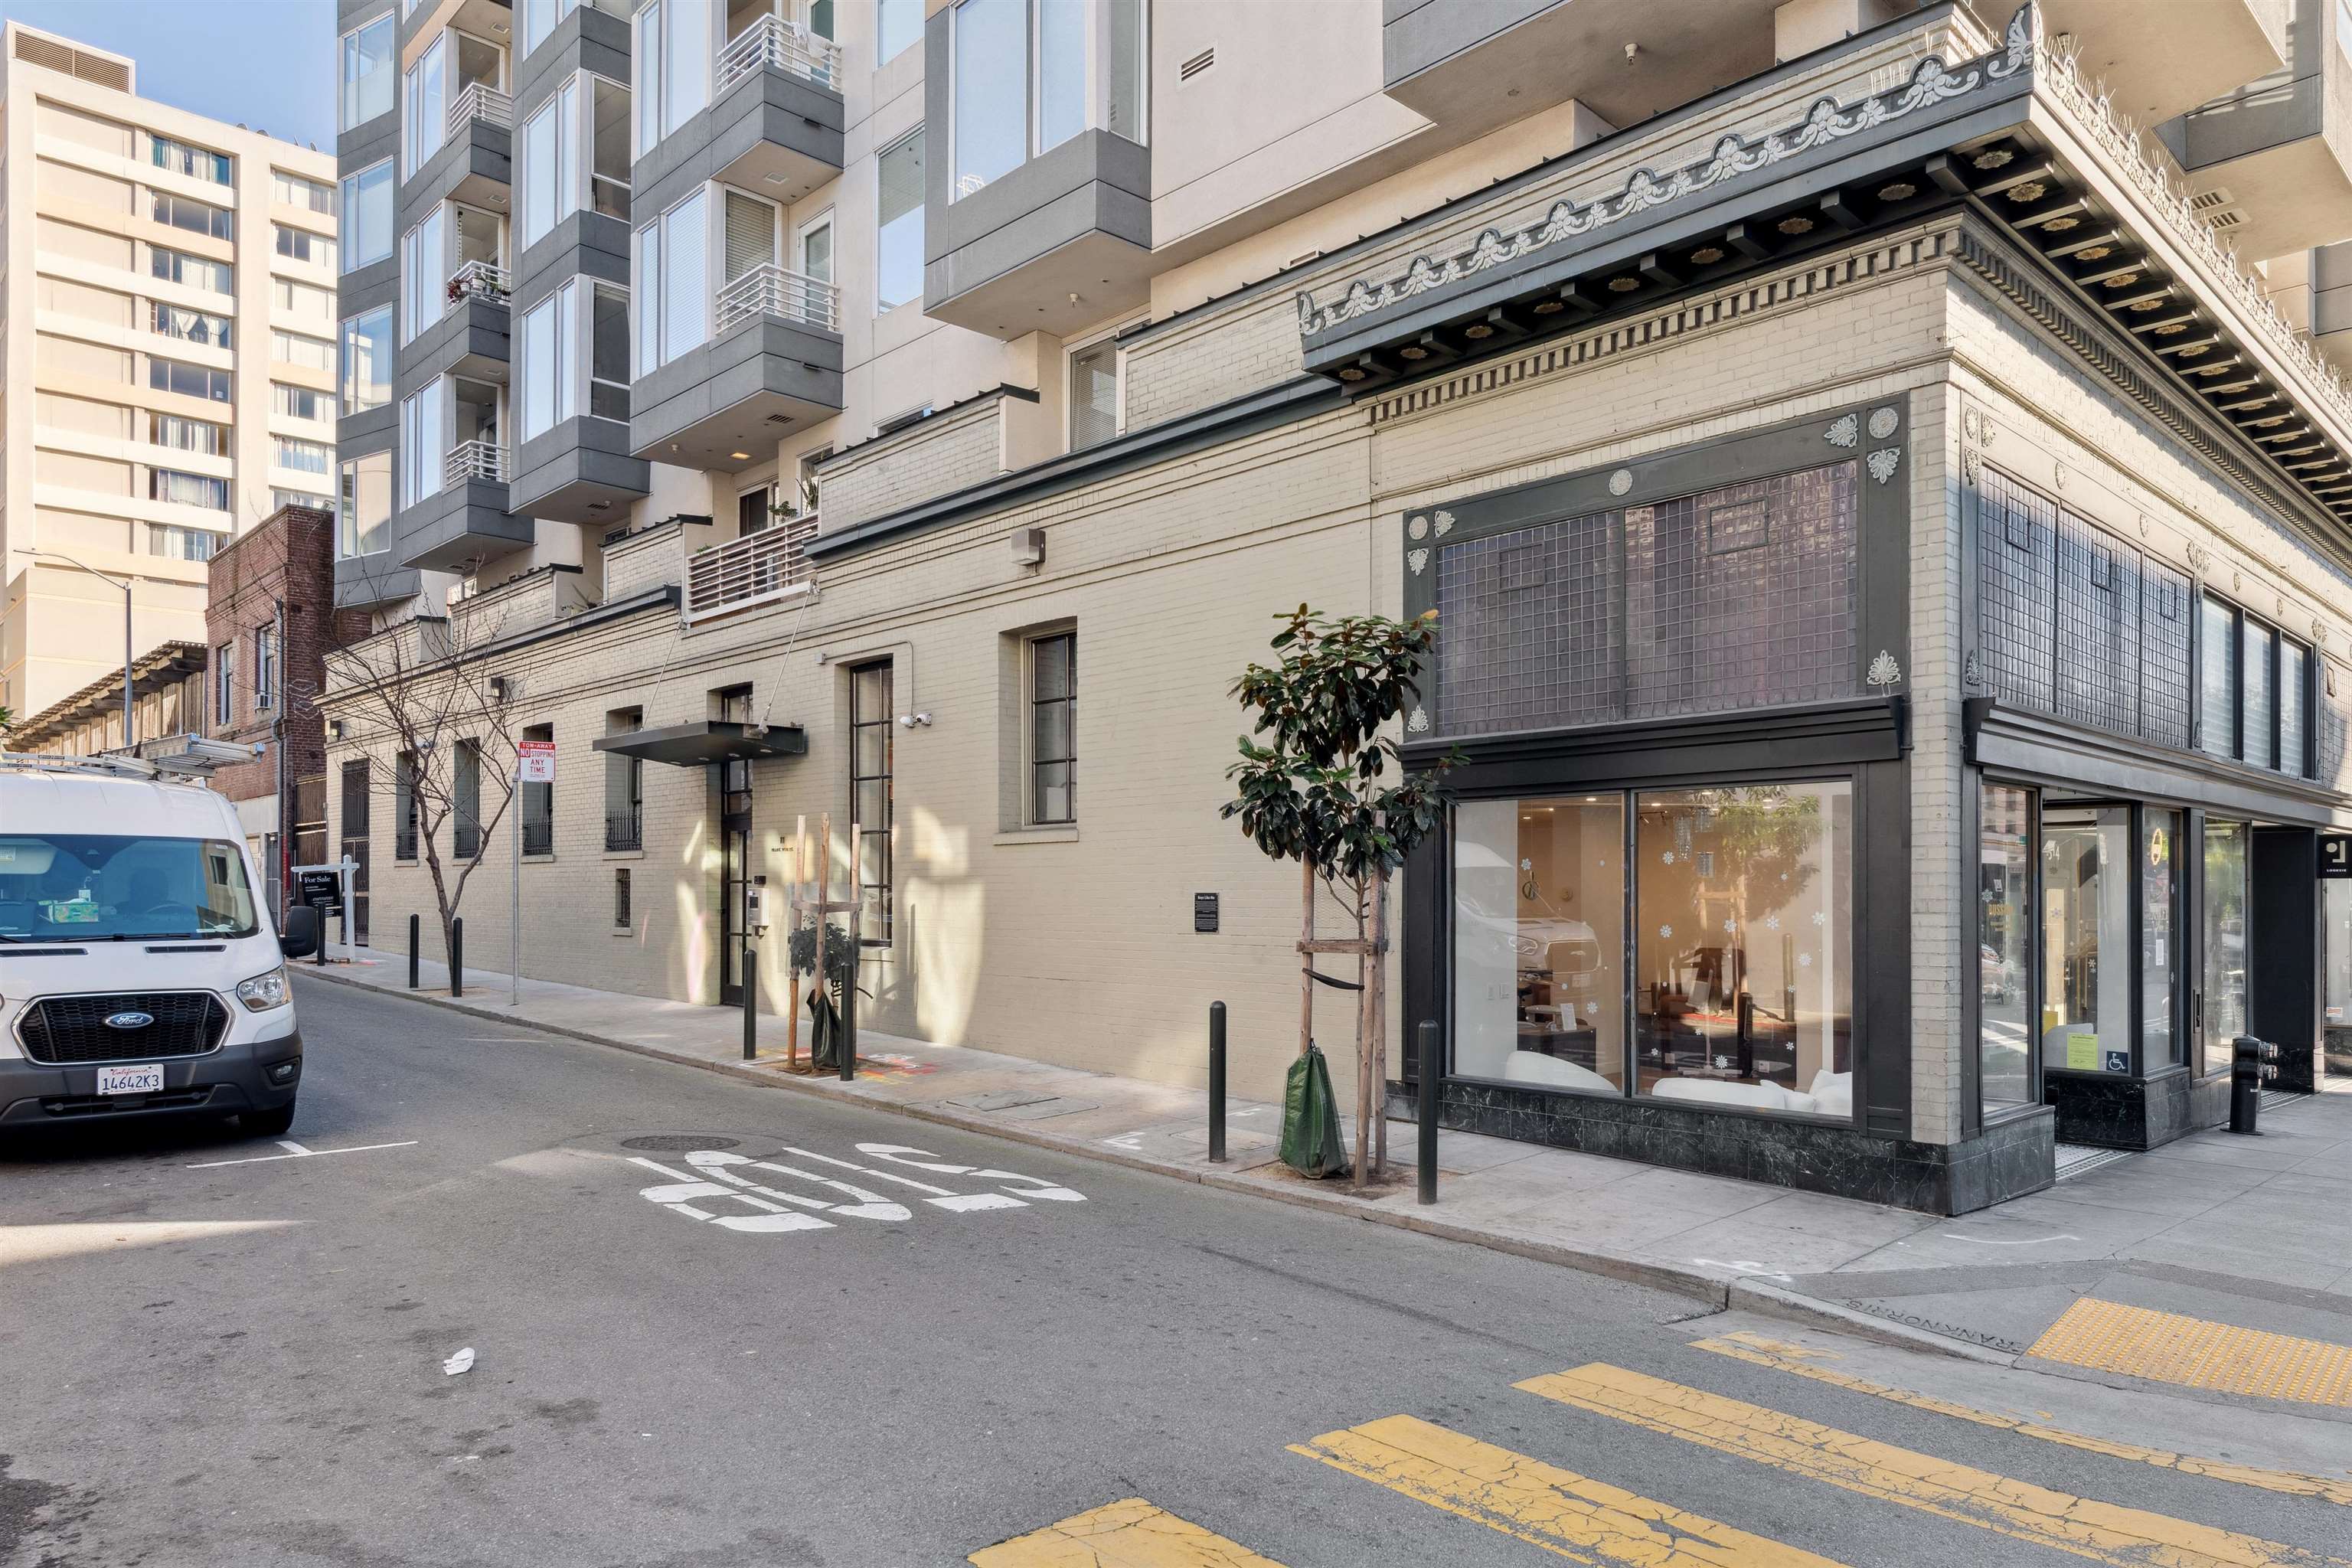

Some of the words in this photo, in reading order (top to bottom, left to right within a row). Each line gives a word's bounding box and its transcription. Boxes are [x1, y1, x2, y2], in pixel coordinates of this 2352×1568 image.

[521, 748, 531, 757] NO
[116, 1015, 143, 1024] Ford
[103, 1075, 159, 1090] 14642K3
